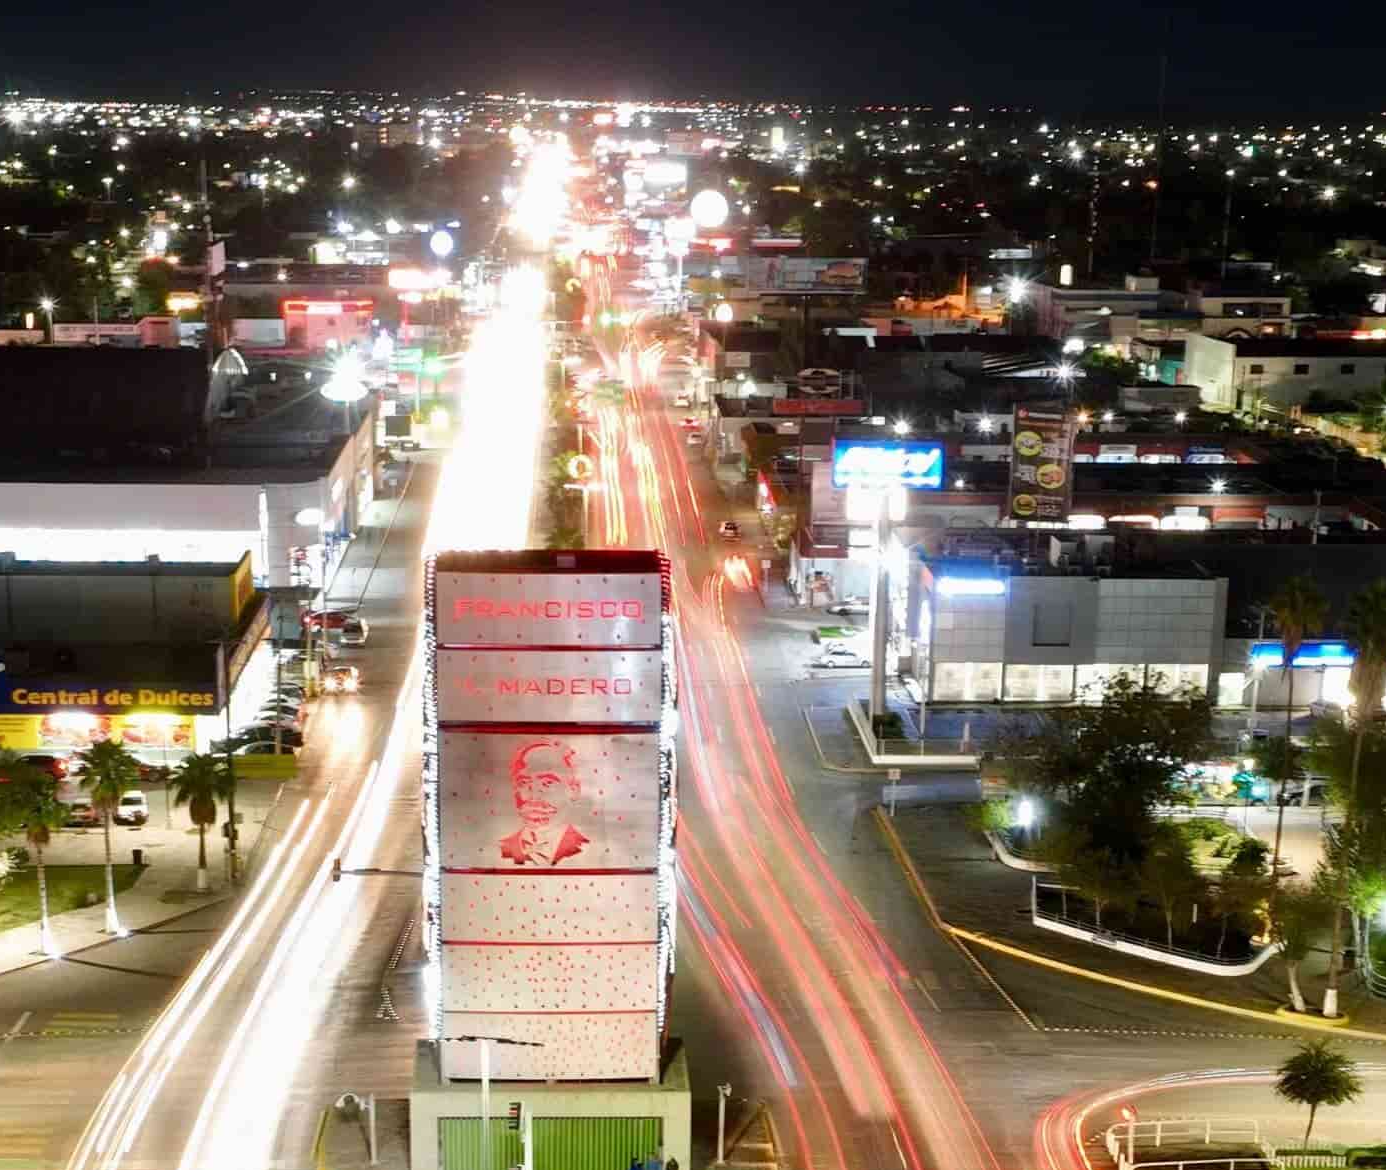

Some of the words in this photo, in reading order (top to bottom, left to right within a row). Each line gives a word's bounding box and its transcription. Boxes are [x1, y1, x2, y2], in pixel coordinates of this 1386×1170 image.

[454, 600, 642, 619] FRANCISCO
[497, 678, 632, 695] MADERO
[12, 688, 98, 705] Central
[103, 690, 133, 705] de
[139, 689, 214, 705] Dulces
